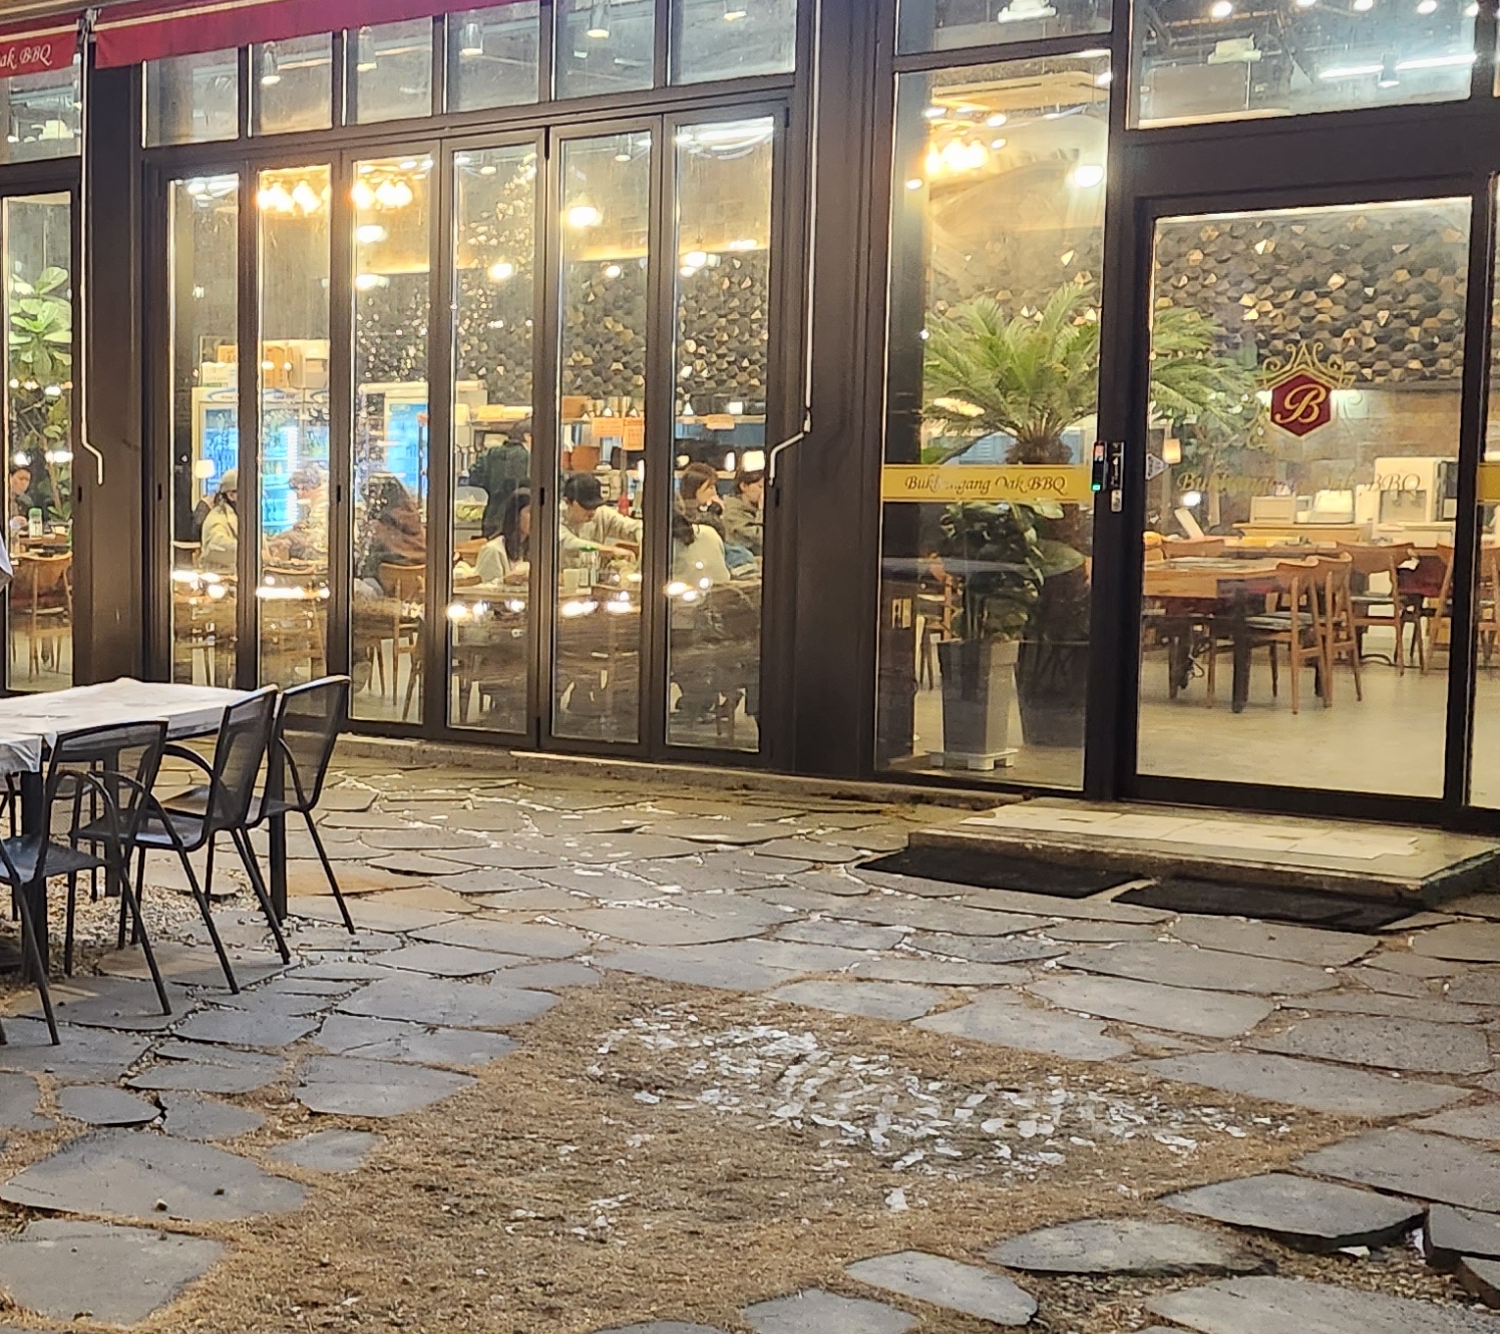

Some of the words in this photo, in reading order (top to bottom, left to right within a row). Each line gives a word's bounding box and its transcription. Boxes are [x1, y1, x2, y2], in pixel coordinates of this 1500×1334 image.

[19, 44, 53, 66] BBQ
[1274, 383, 1327, 424] B
[1025, 476, 1068, 496] BBQ
